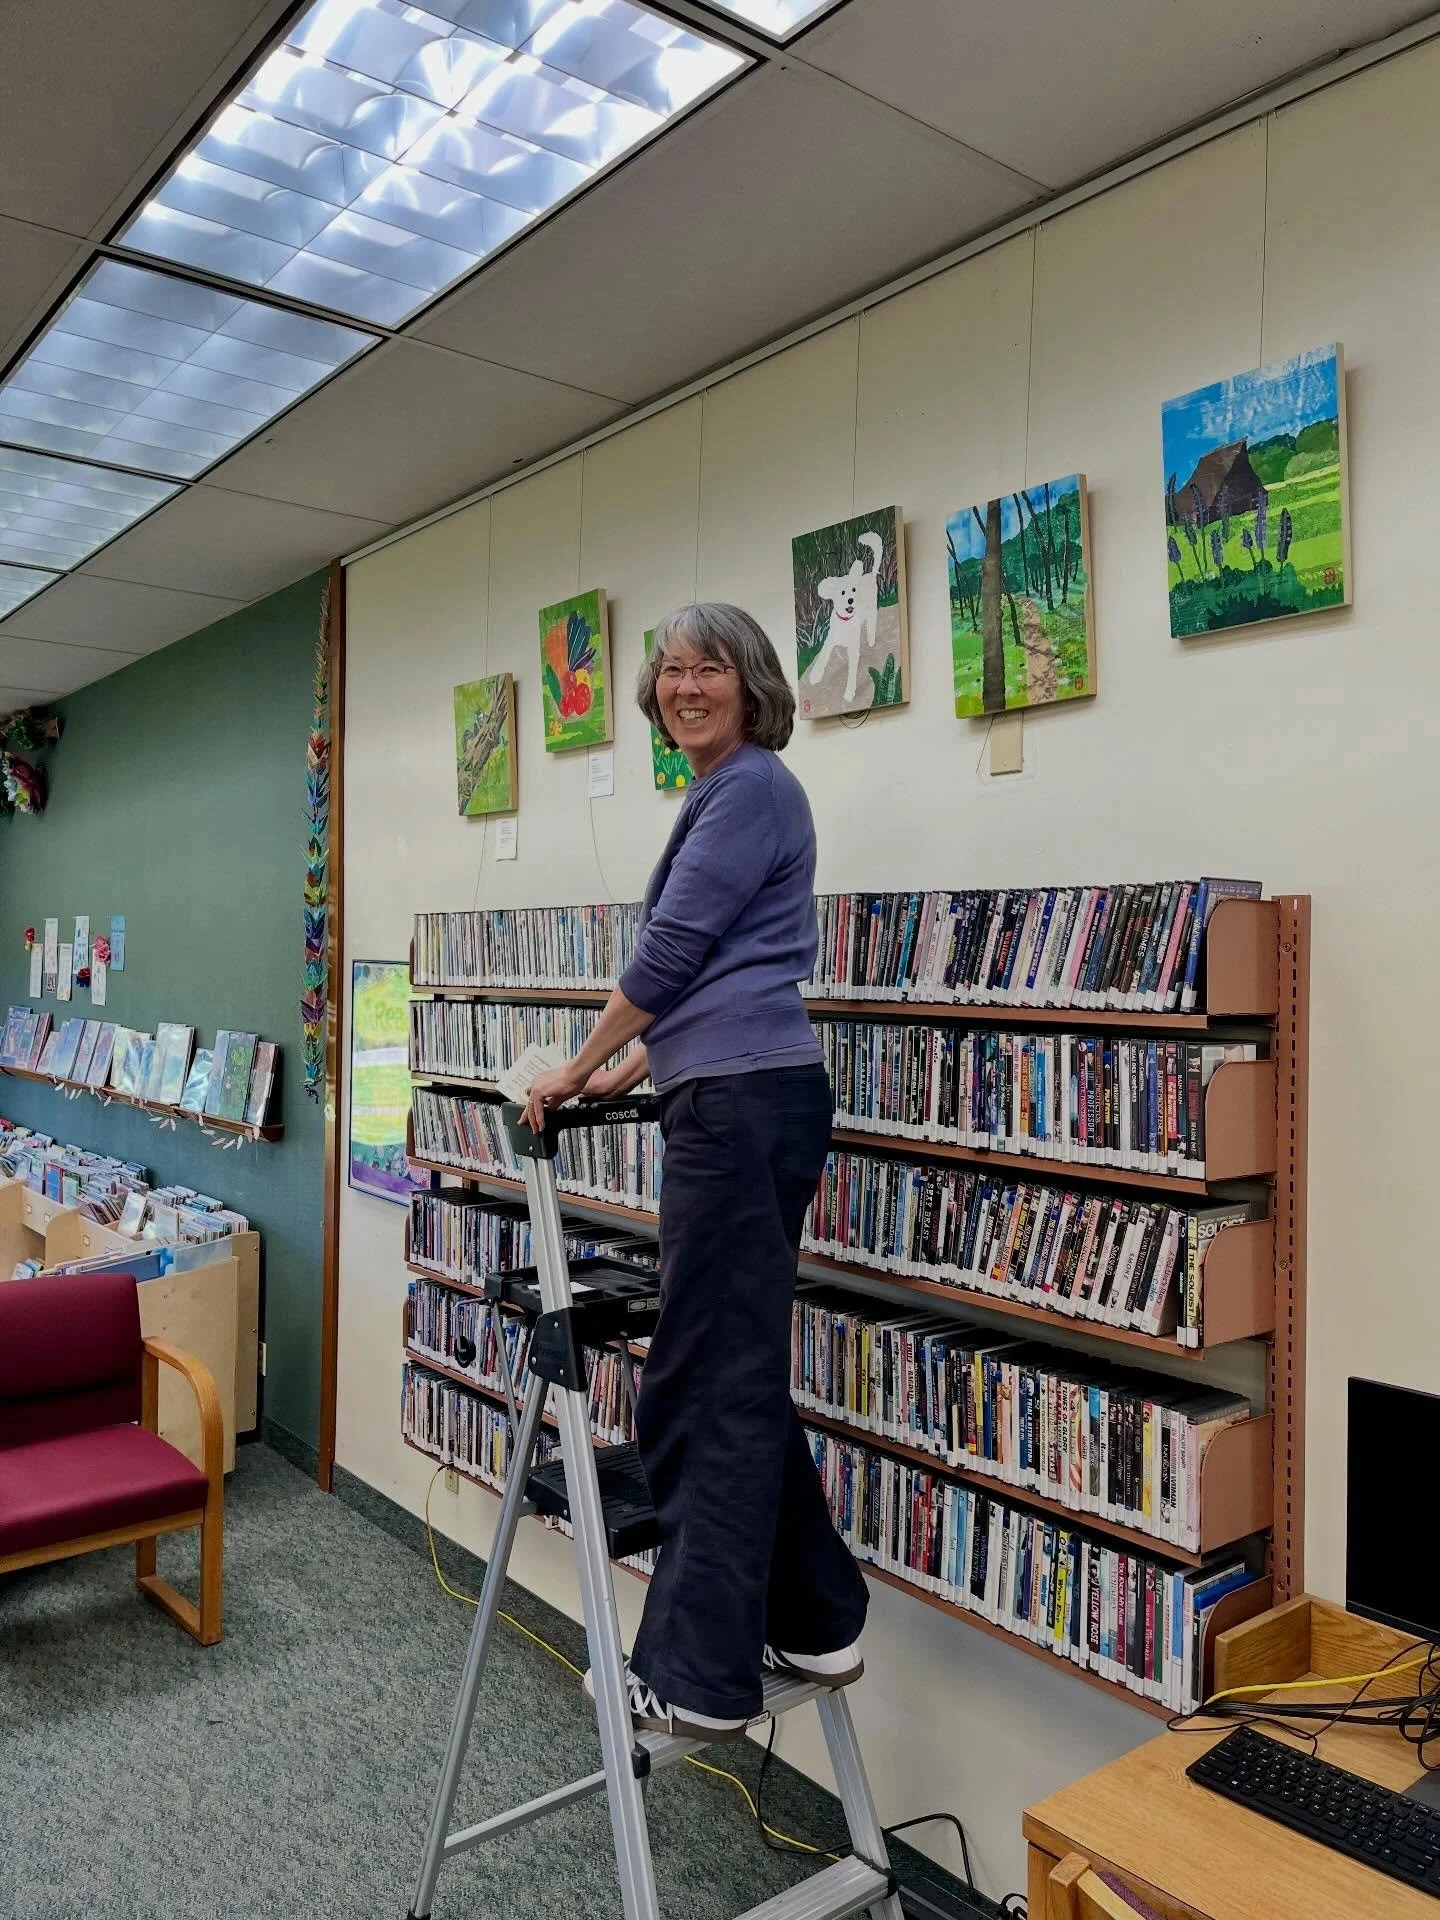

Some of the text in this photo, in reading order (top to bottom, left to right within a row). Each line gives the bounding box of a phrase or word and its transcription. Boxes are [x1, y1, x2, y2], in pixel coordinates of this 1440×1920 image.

[1137, 927, 1151, 957] HOMES
[923, 1183, 934, 1241] SEXY BEAST
[1105, 1245, 1120, 1276] SMASHED
[1123, 1252, 1135, 1280] SMOKE
[1090, 1622, 1099, 1644] ROSE
